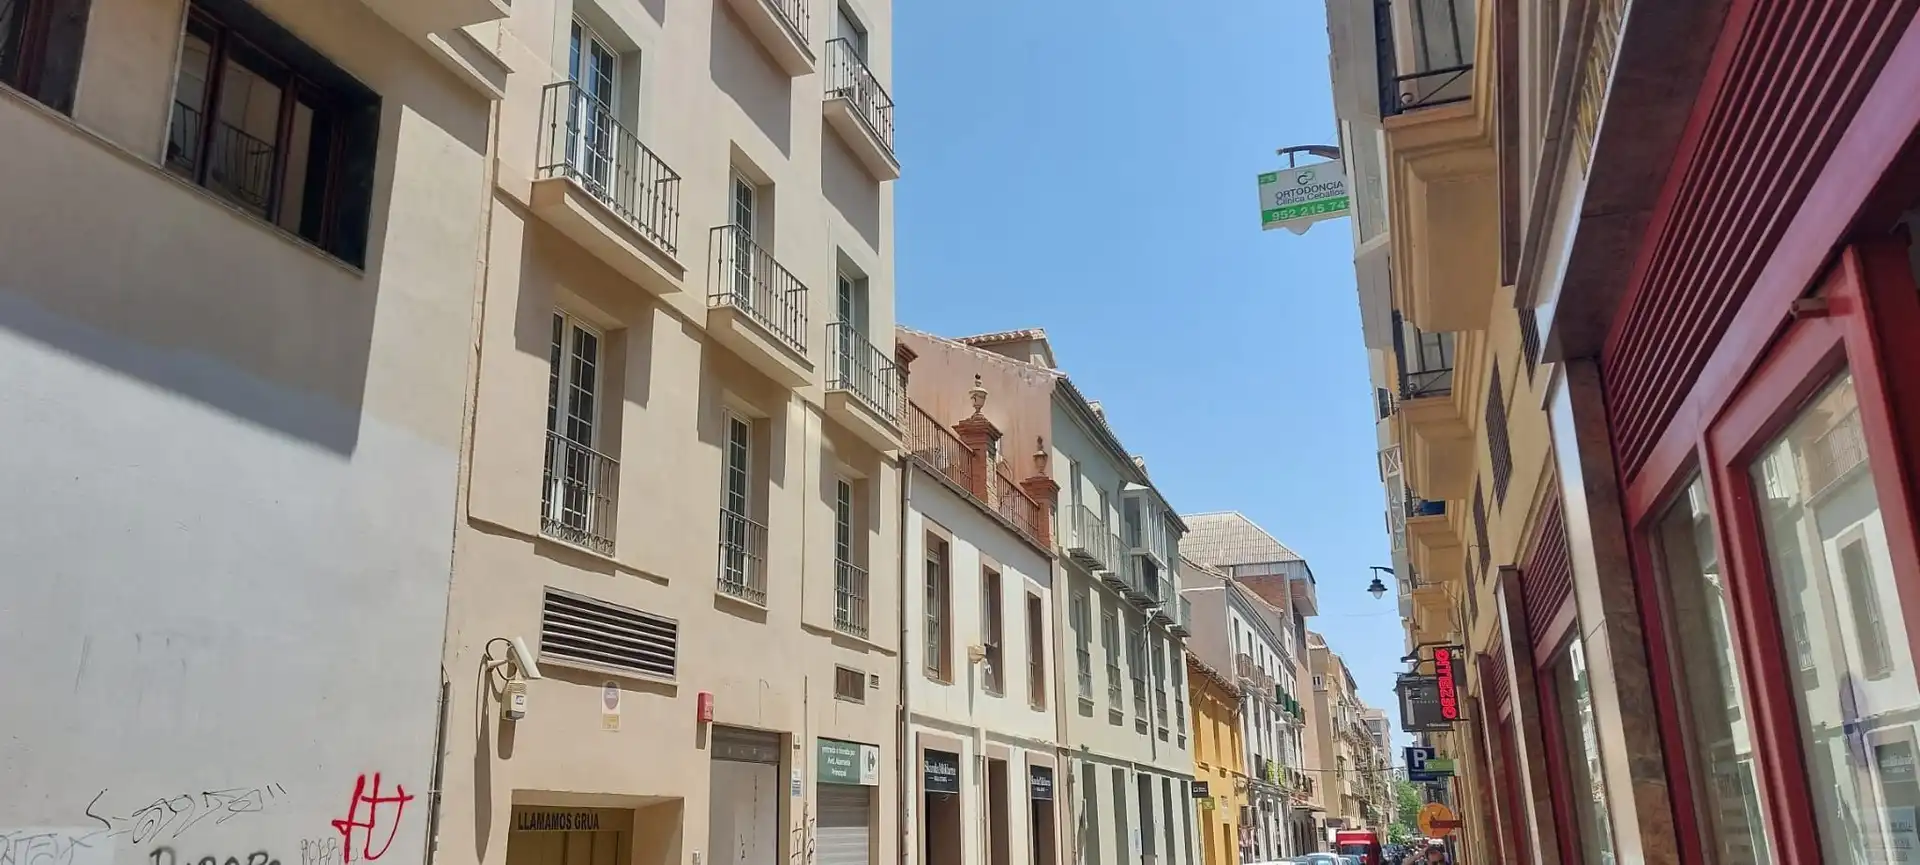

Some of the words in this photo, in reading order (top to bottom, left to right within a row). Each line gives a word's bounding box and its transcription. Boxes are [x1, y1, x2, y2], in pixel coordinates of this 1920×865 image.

[1275, 180, 1344, 200] ORTODONCIA
[1272, 208, 1296, 221] 952
[1300, 203, 1325, 216] 215
[1329, 200, 1350, 211] 74
[1413, 749, 1428, 768] P
[518, 811, 572, 830] LLAMAMOS
[574, 812, 600, 830] GRUA
